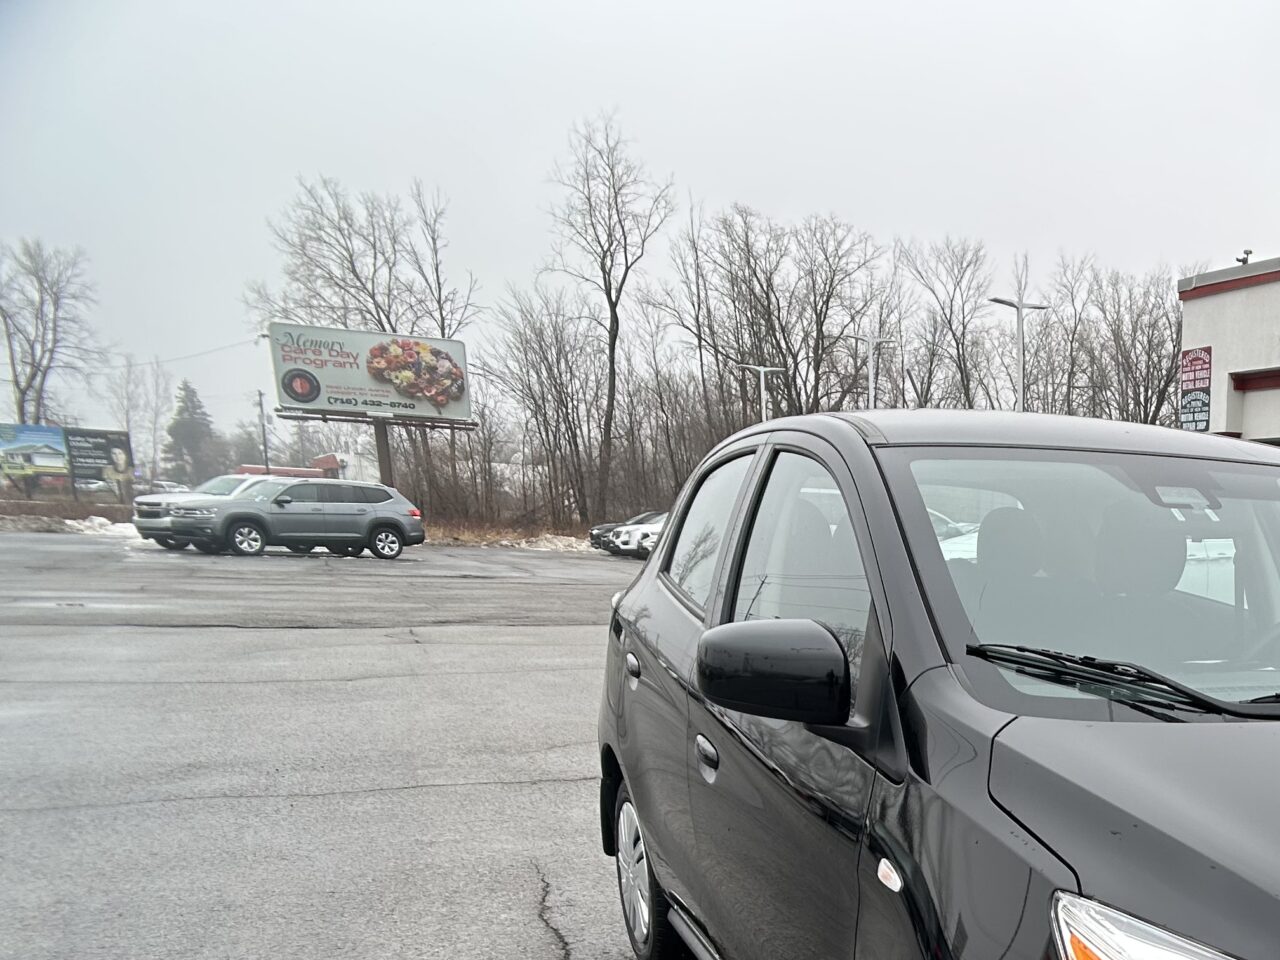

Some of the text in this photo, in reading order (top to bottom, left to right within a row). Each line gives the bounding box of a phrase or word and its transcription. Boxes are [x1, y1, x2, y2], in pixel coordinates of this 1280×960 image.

[275, 331, 345, 351] Memory
[281, 344, 359, 362] Care Day
[1183, 349, 1210, 366] REGISTERED
[282, 354, 360, 369] Program
[1182, 391, 1209, 406] REGISTERED
[1194, 411, 1209, 420] VEHICLE
